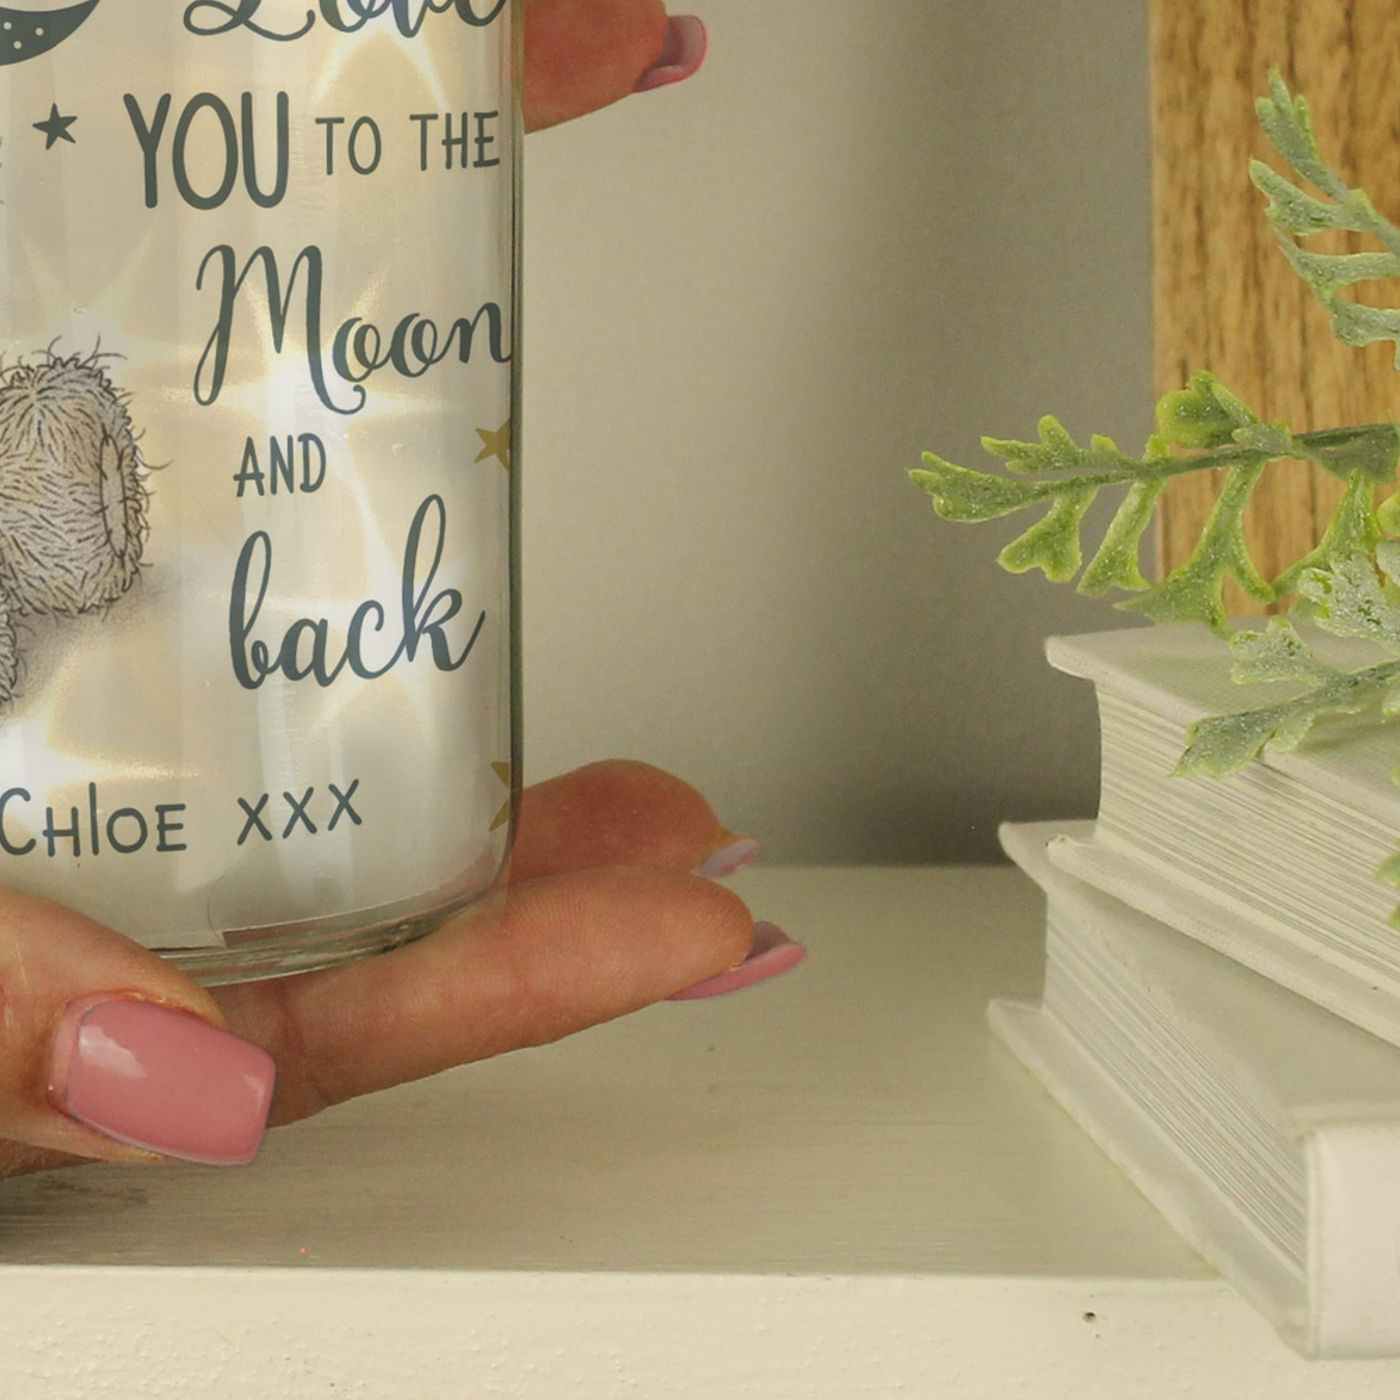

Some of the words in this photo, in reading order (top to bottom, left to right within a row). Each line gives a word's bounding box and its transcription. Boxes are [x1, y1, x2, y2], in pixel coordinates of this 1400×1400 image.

[123, 91, 290, 210] YOU
[315, 116, 382, 176] TO
[409, 111, 501, 171] THE
[193, 245, 513, 415] Moon
[233, 433, 327, 497] AND
[229, 494, 486, 690] back
